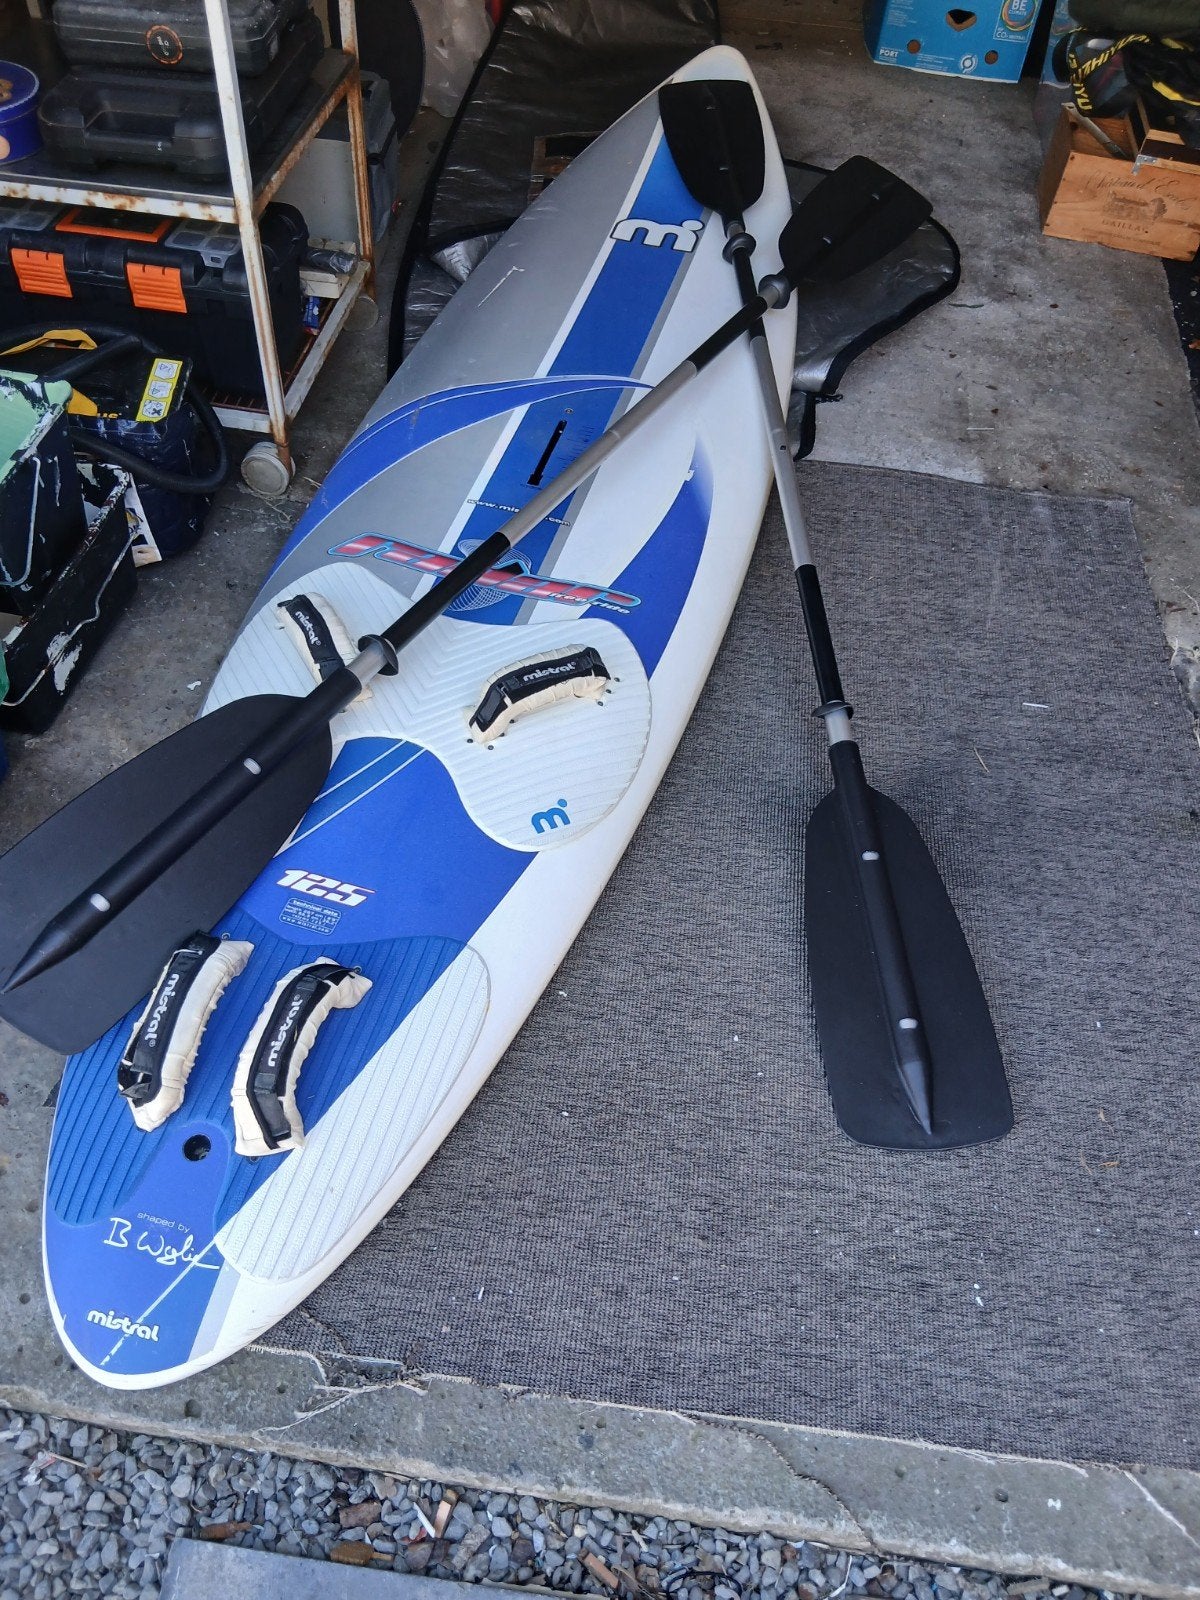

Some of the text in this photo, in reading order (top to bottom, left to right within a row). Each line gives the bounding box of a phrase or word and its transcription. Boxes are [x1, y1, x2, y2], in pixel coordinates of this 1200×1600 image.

[879, 48, 899, 58] PORT
[275, 868, 377, 908] 125
[136, 1211, 191, 1234] shaped by
[86, 1308, 160, 1342] mistral
